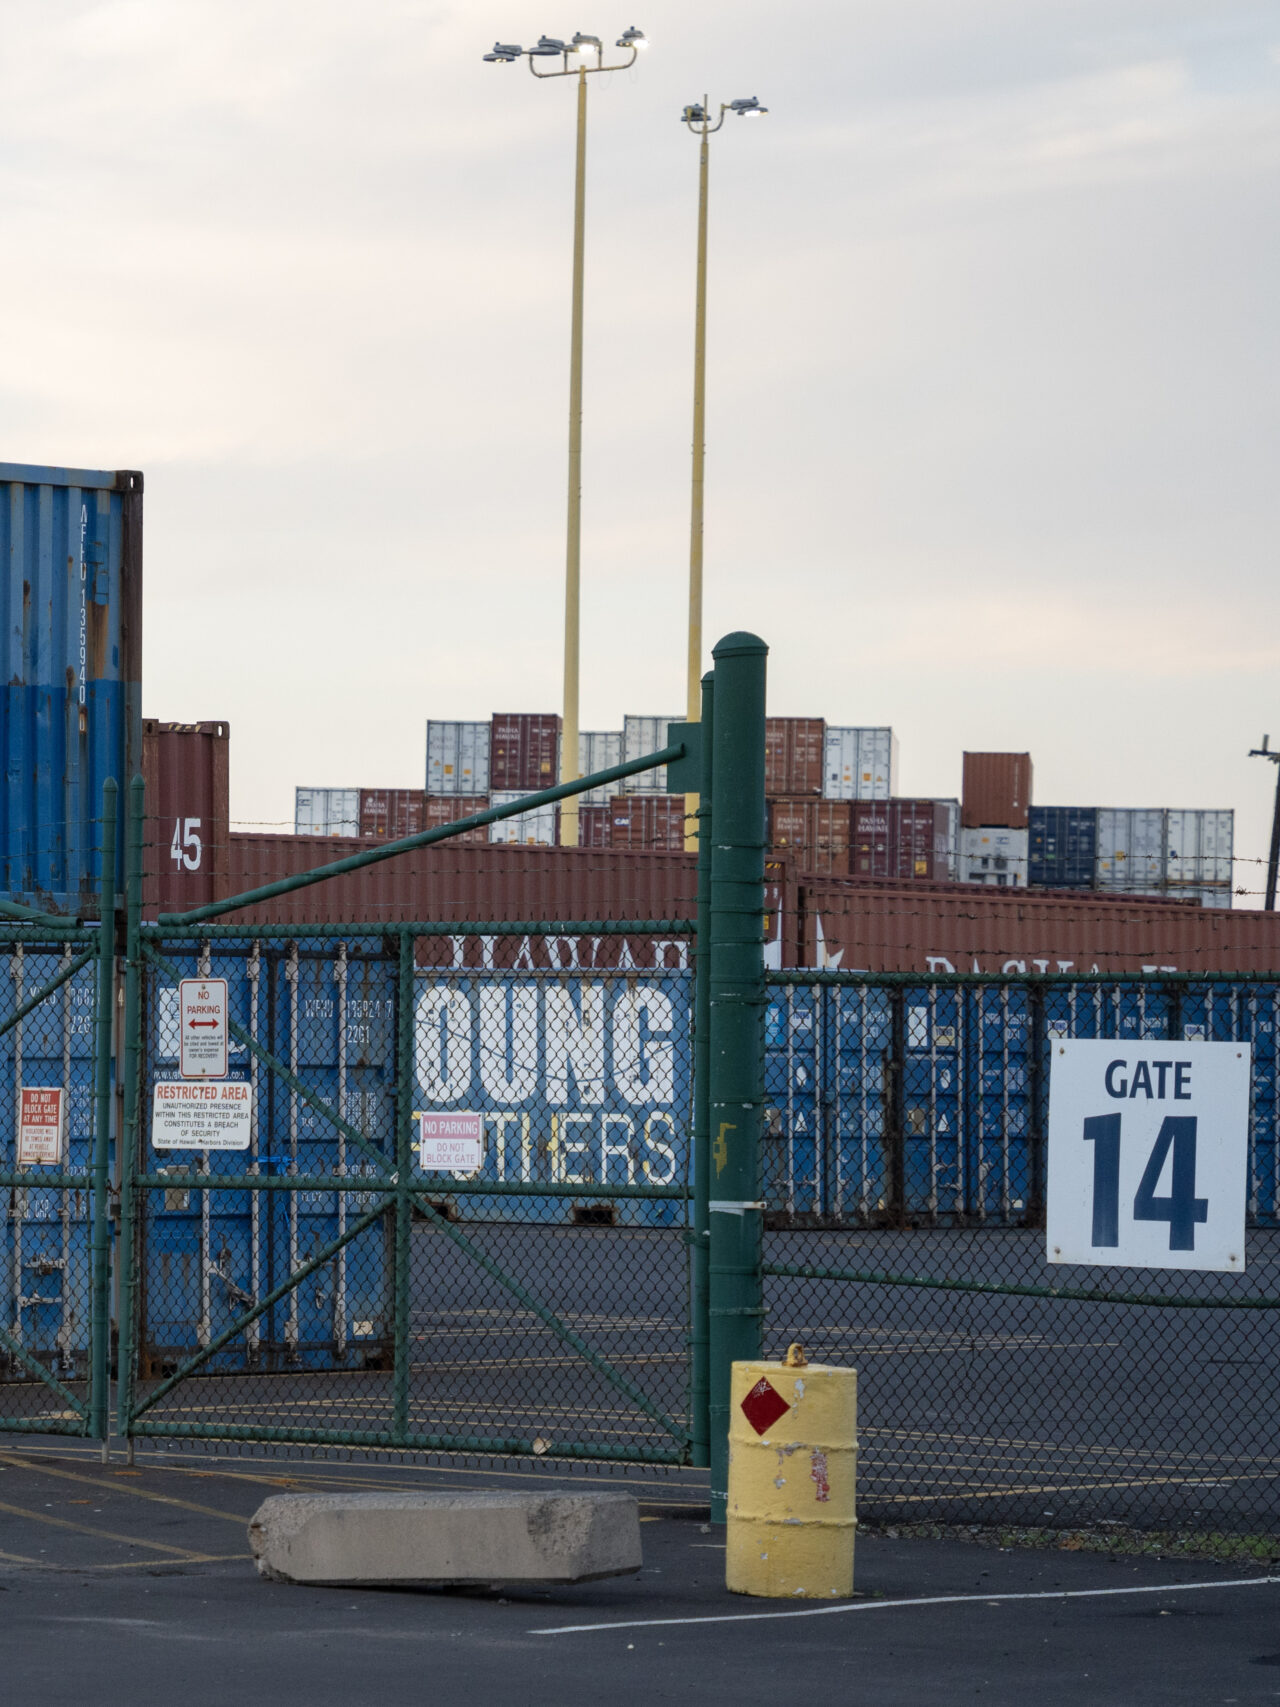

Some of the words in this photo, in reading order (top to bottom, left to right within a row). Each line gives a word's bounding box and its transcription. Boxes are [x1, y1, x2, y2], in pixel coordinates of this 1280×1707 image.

[170, 817, 202, 871] 45
[197, 991, 210, 1000] NO
[186, 1005, 221, 1014] PARKING
[414, 985, 674, 1105] OUNG
[1104, 1059, 1192, 1100] GATE
[30, 1093, 38, 1103] DO
[40, 1093, 51, 1103] NOT
[157, 1086, 218, 1100] RESTRICTED
[221, 1086, 248, 1100] AREA
[24, 1104, 42, 1114] BLOCK
[43, 1104, 57, 1114] GATE
[163, 1102, 208, 1110] UNAUTHORIZED
[32, 1114, 42, 1123] ANY
[45, 1114, 57, 1123] TIME
[164, 1120, 204, 1128] CONSTITUTES
[424, 1121, 437, 1135] NO
[439, 1121, 478, 1135] PARKING
[411, 1109, 676, 1185] THERS
[436, 1143, 448, 1152] DO
[450, 1143, 464, 1152] NOT
[426, 1154, 452, 1163] BLOCK
[454, 1154, 475, 1164] GATE
[1083, 1112, 1209, 1251] 14
